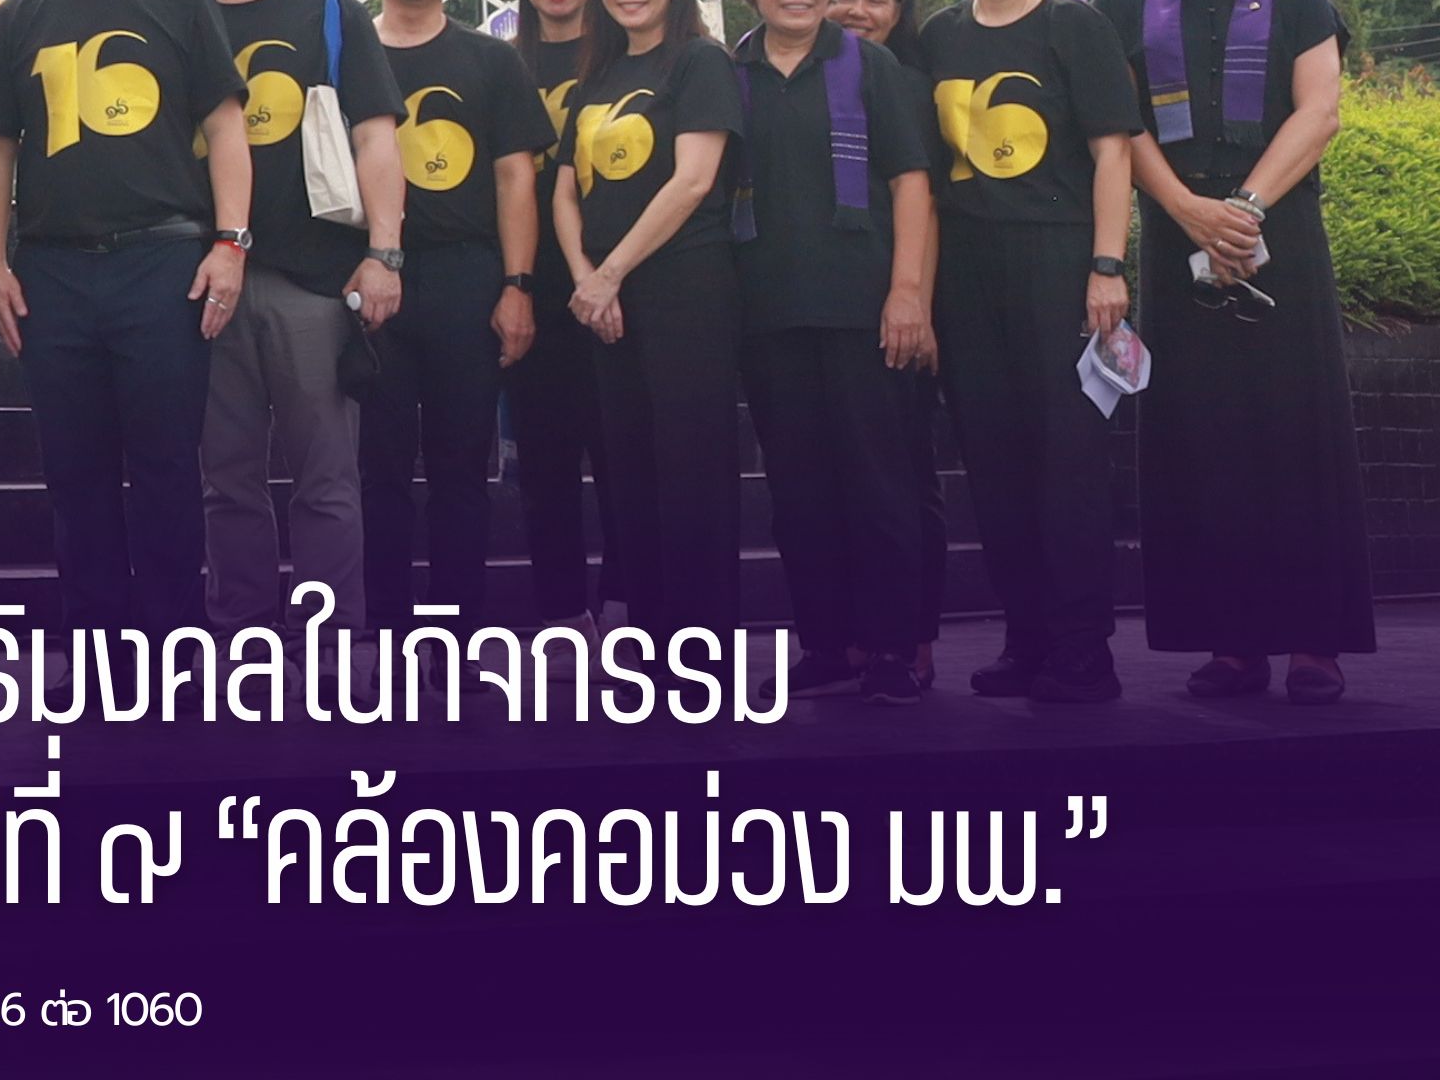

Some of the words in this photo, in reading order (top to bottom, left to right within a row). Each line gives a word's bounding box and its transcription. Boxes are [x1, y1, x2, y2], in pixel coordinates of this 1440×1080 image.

[31, 30, 161, 158] 16
[574, 88, 656, 200] 16
[932, 71, 1050, 183] 16
